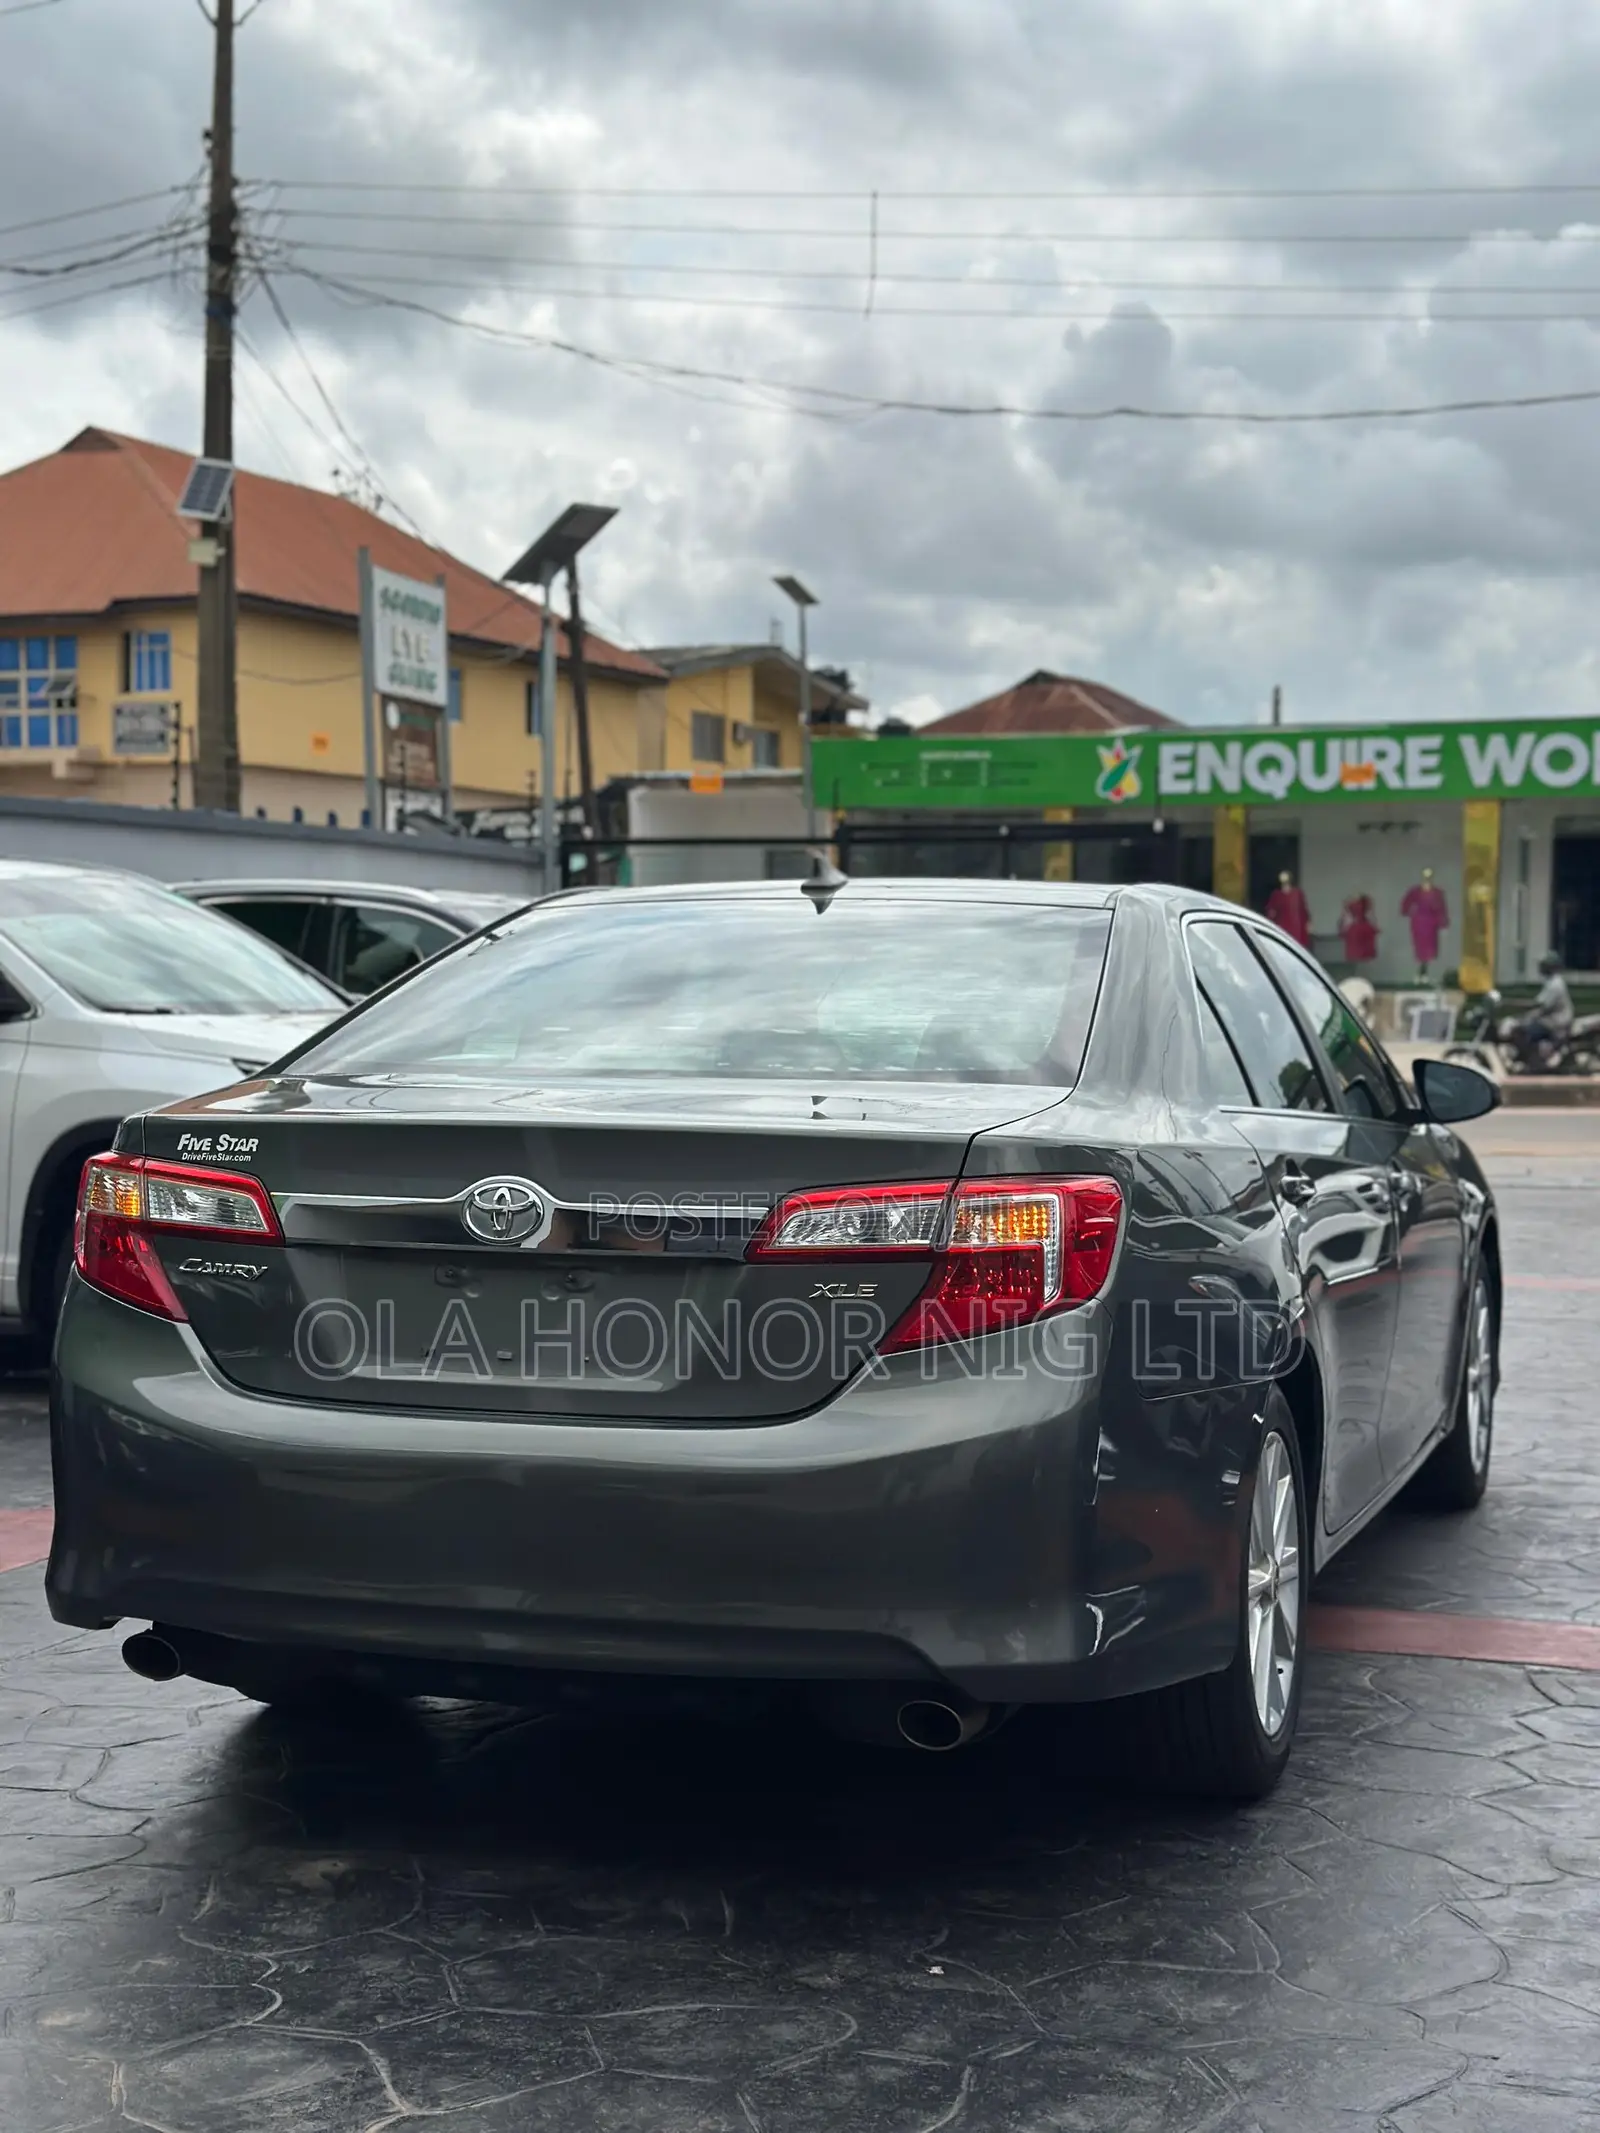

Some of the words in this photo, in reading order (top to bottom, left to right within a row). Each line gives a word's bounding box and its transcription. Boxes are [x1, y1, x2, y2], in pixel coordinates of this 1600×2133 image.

[1158, 734, 1444, 798] ENQUIRE
[182, 1152, 252, 1162] DriveFiveStar.com
[808, 1283, 879, 1299] XLE
